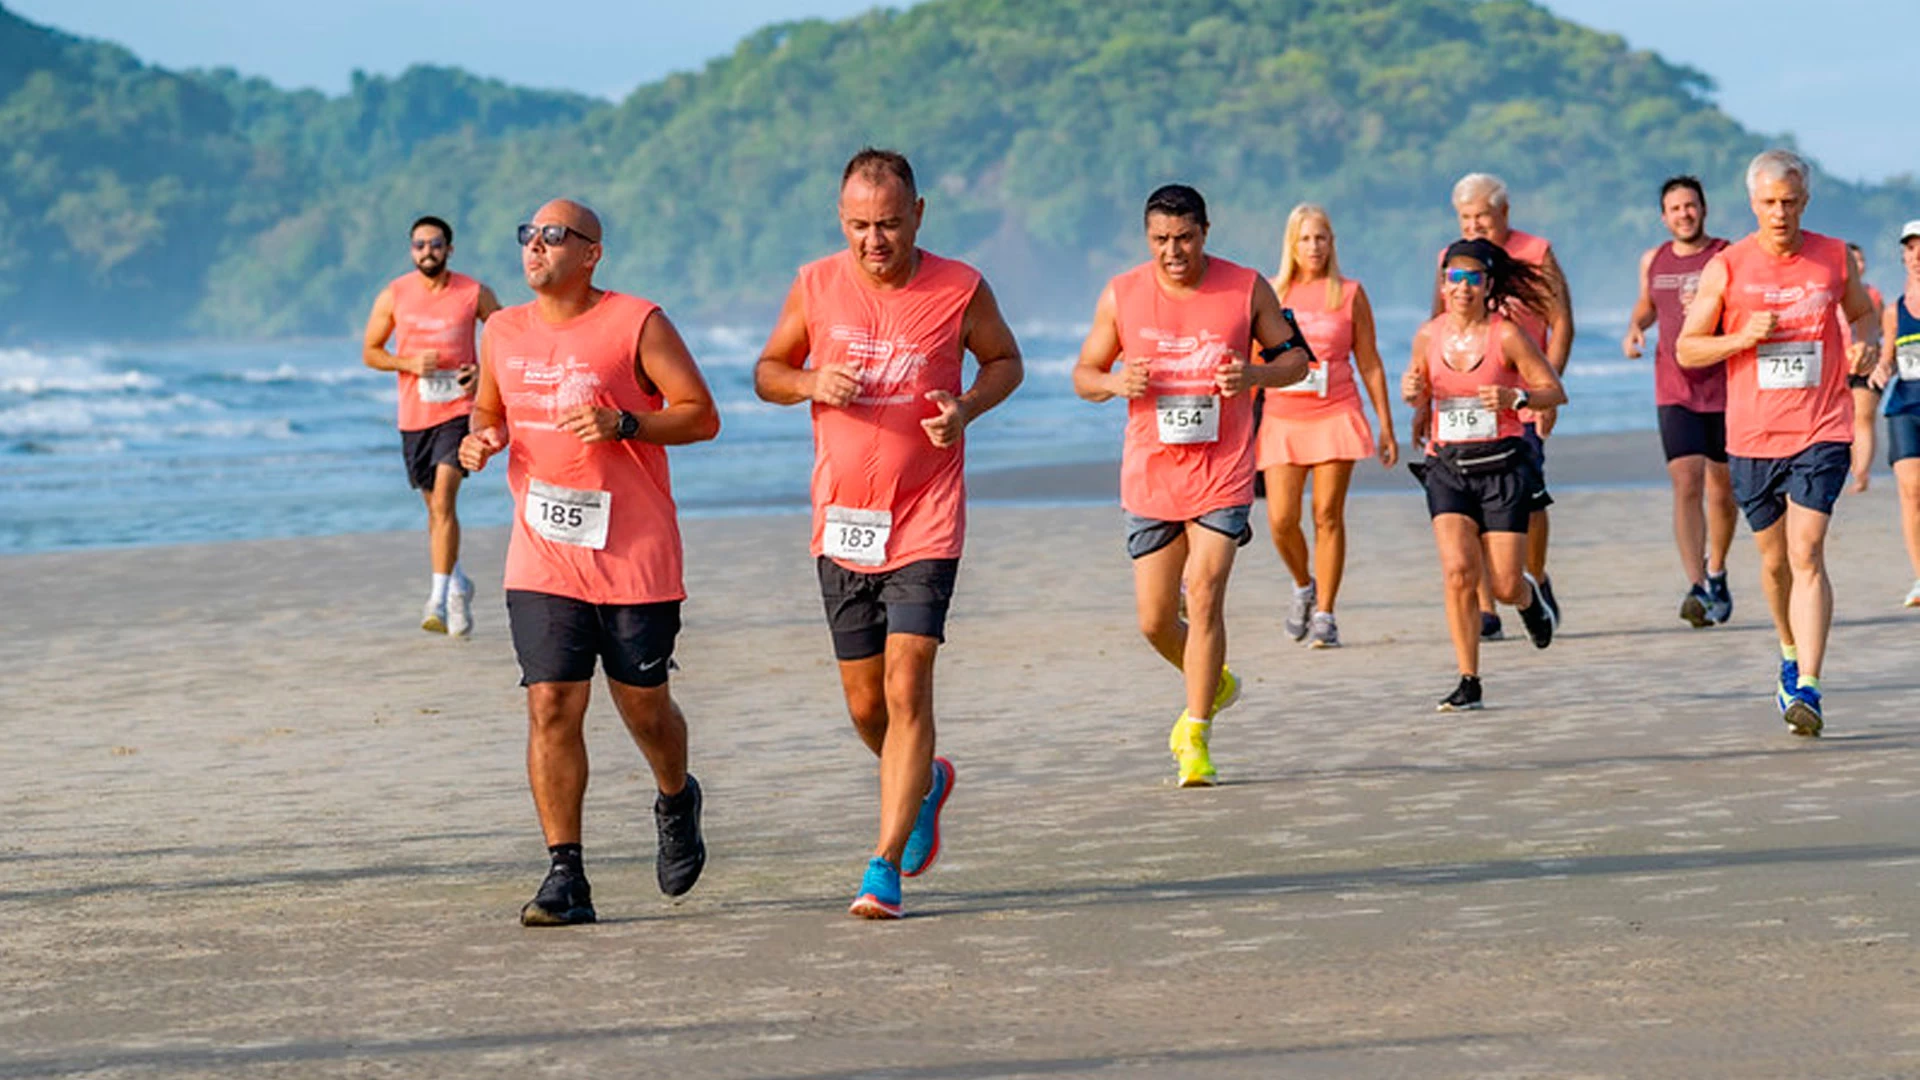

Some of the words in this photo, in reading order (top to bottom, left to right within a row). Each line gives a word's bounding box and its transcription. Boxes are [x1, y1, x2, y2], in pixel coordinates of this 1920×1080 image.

[1769, 358, 1804, 373] 714
[1163, 410, 1202, 427] 454
[1447, 411, 1478, 427] 916
[540, 502, 582, 527] 185
[840, 527, 876, 548] 183
